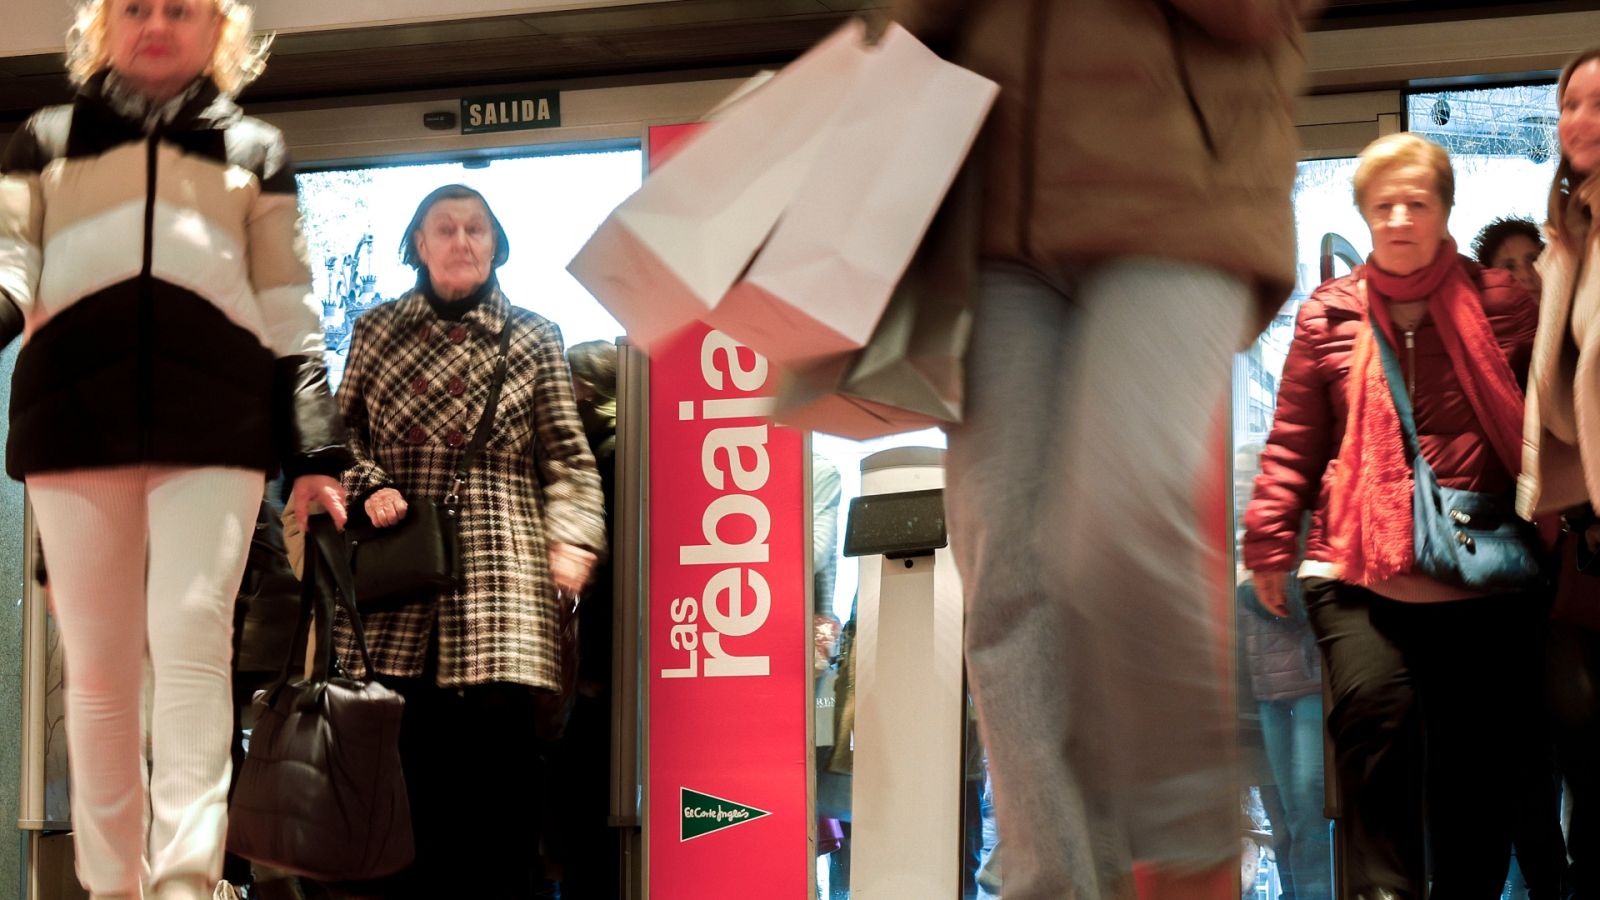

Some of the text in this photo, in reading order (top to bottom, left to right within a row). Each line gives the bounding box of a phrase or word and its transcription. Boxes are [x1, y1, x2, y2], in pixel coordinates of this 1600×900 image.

[469, 98, 551, 126] SALIDA
[679, 329, 786, 678] rebaja
[661, 597, 698, 678] Las
[684, 804, 749, 822] El Corte Inglés
